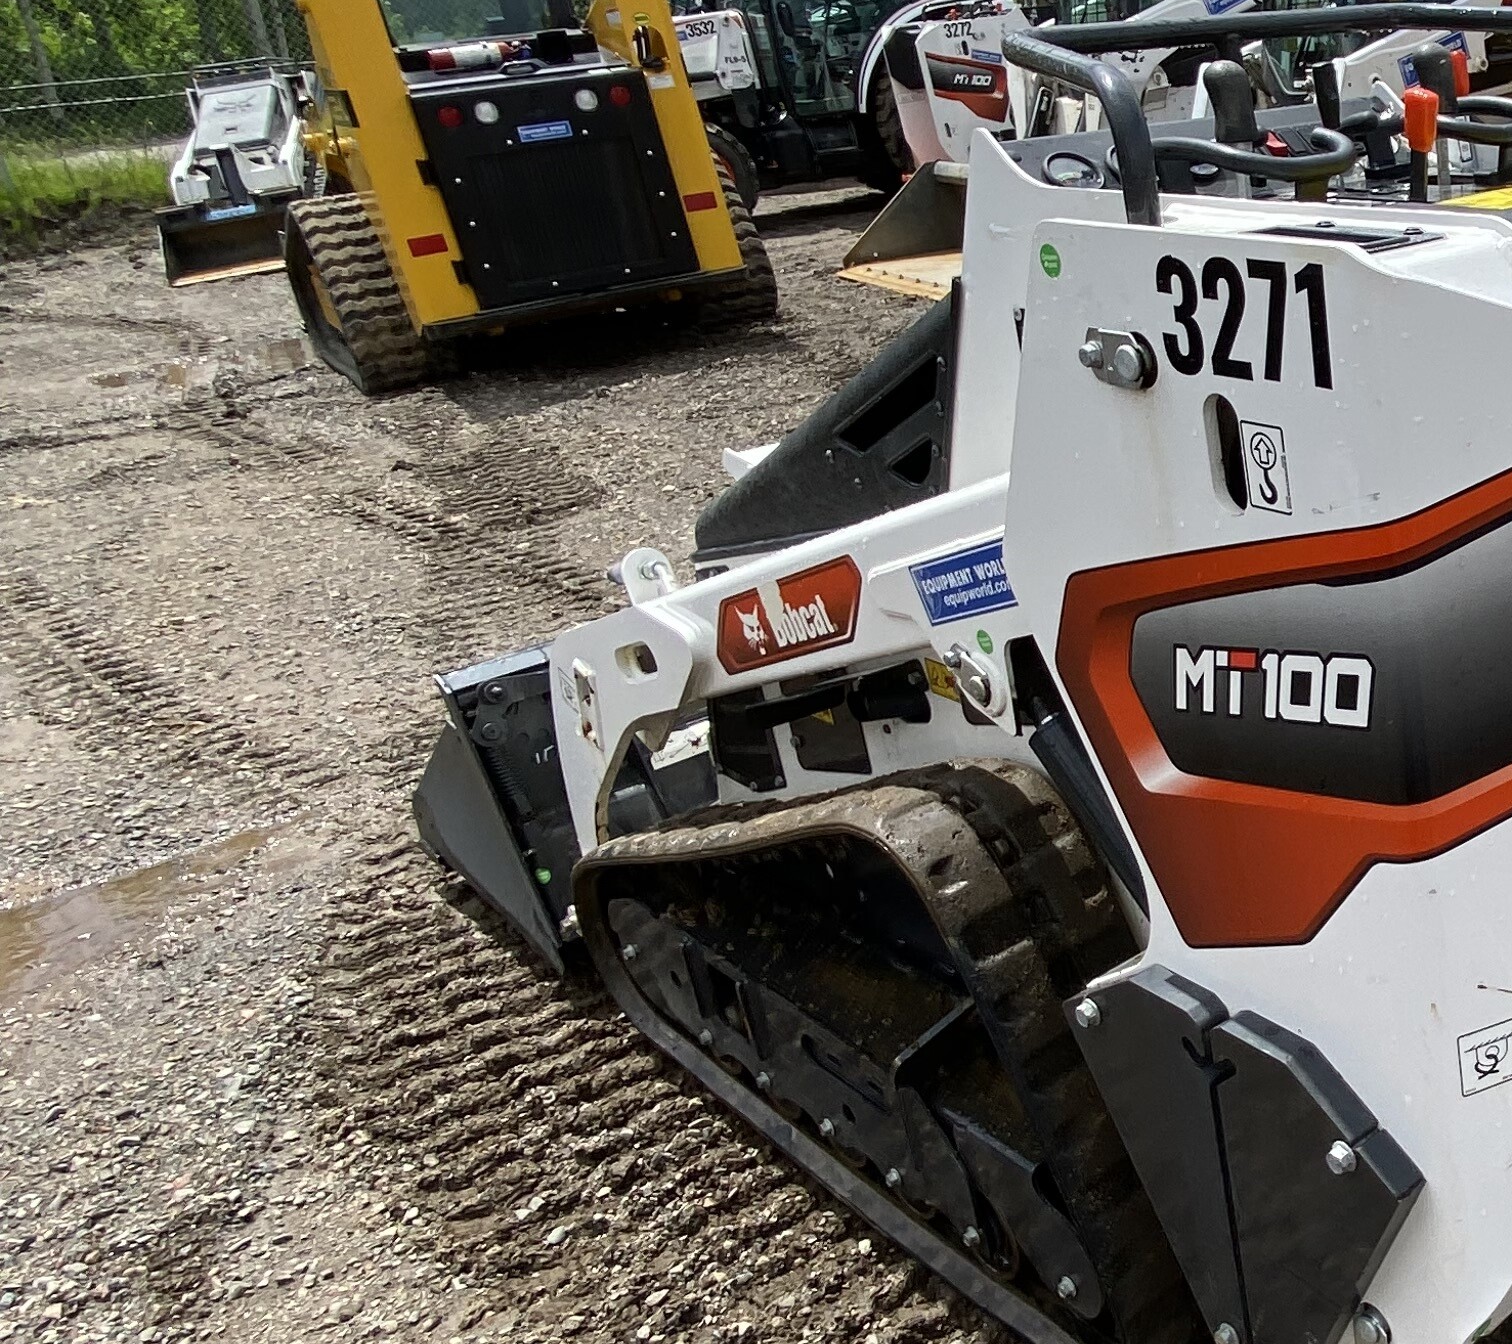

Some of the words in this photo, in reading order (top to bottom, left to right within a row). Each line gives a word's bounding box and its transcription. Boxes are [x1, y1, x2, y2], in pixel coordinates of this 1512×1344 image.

[685, 20, 717, 38] 3532
[943, 21, 974, 38] 3272
[1156, 254, 1333, 390] 3271
[921, 568, 974, 595] EQUIPMENT
[973, 558, 1005, 581] WORL
[774, 594, 835, 648] Bobcat
